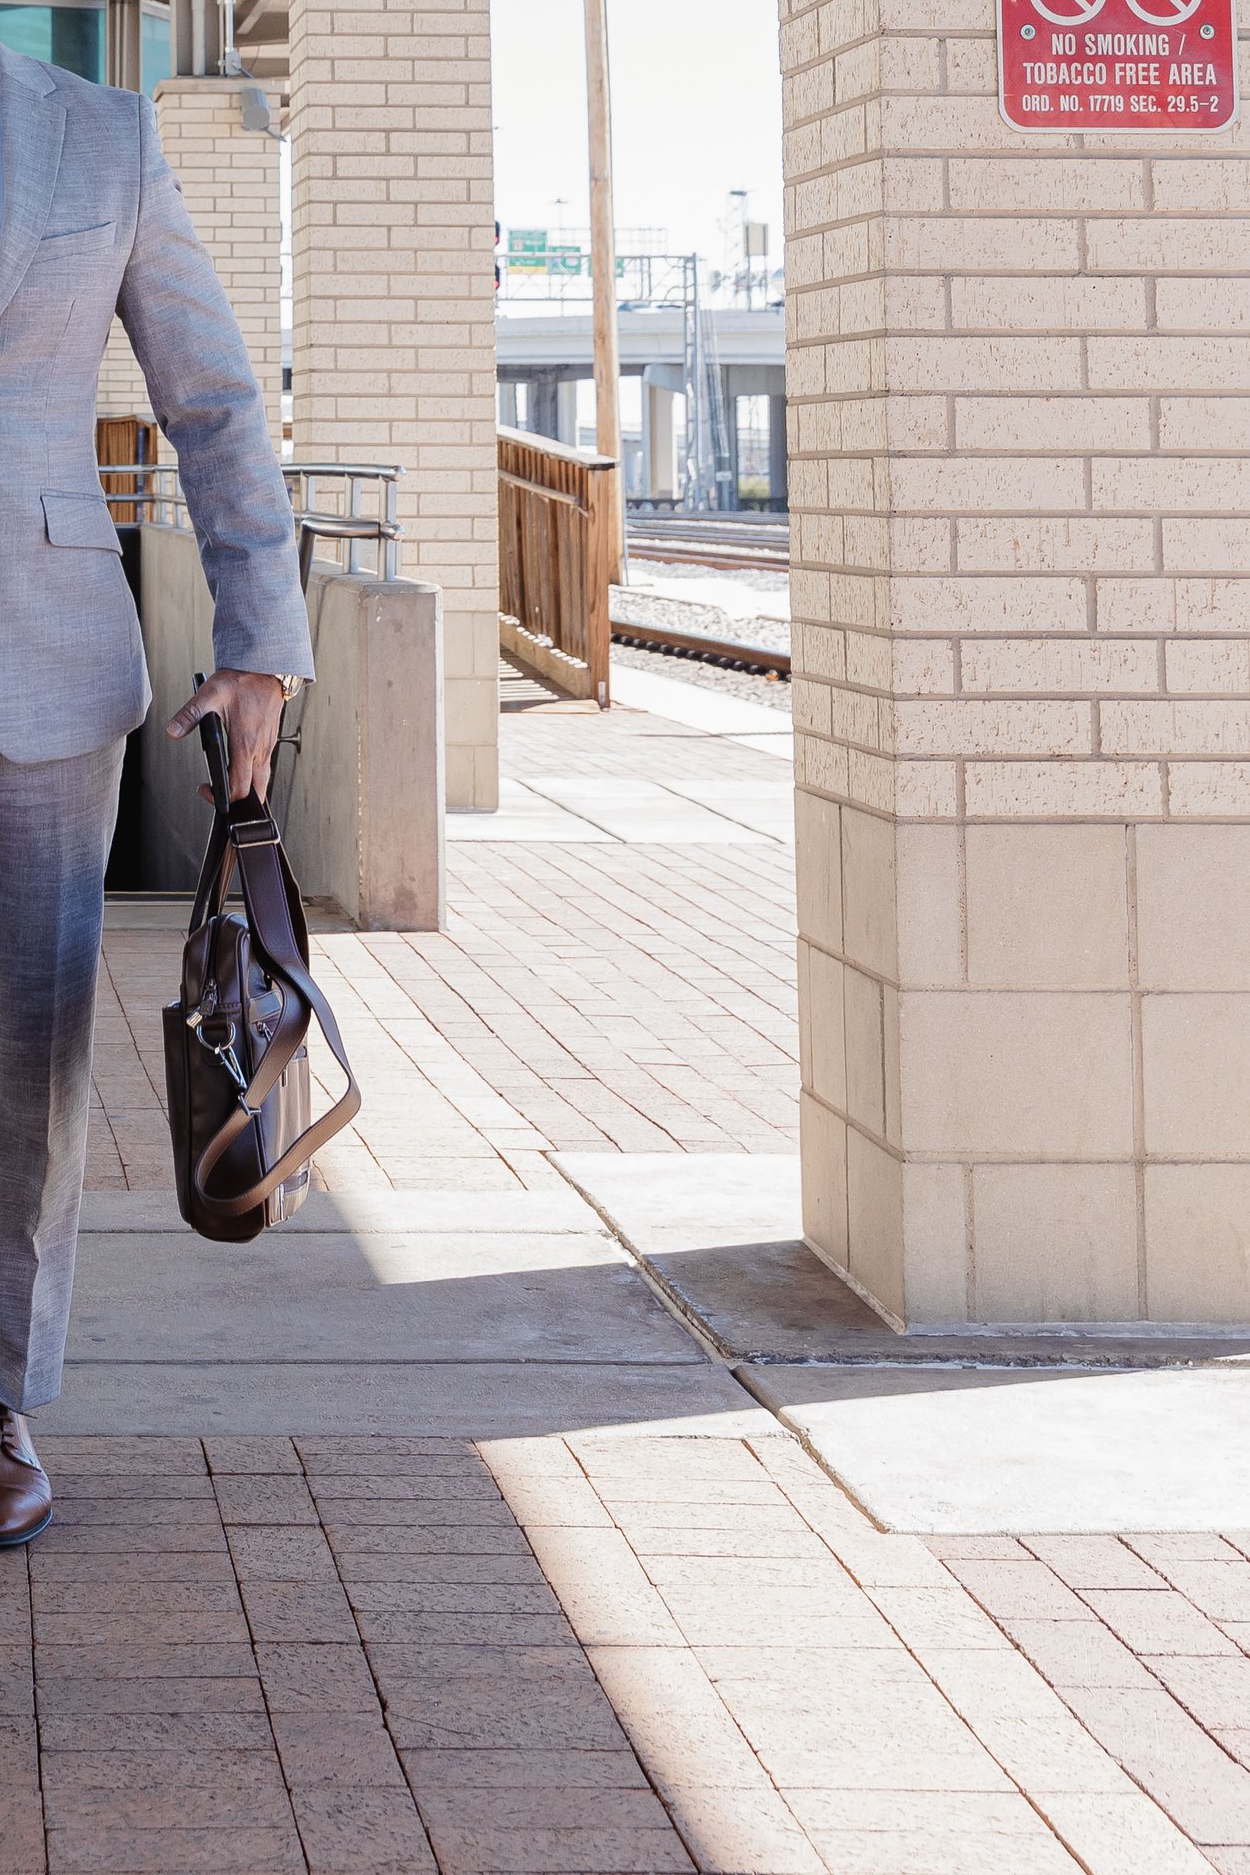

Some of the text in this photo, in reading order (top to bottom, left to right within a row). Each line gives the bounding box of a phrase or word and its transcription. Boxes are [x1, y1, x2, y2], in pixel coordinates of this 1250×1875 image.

[1051, 33, 1076, 56] NO
[1084, 33, 1170, 56] SMOKING
[1022, 62, 1218, 86] TOBACCO FREE AREA
[1021, 94, 1054, 112] ORD.
[1059, 94, 1084, 112] NO.
[1088, 94, 1125, 113] 17719
[1129, 94, 1162, 113] SEC.
